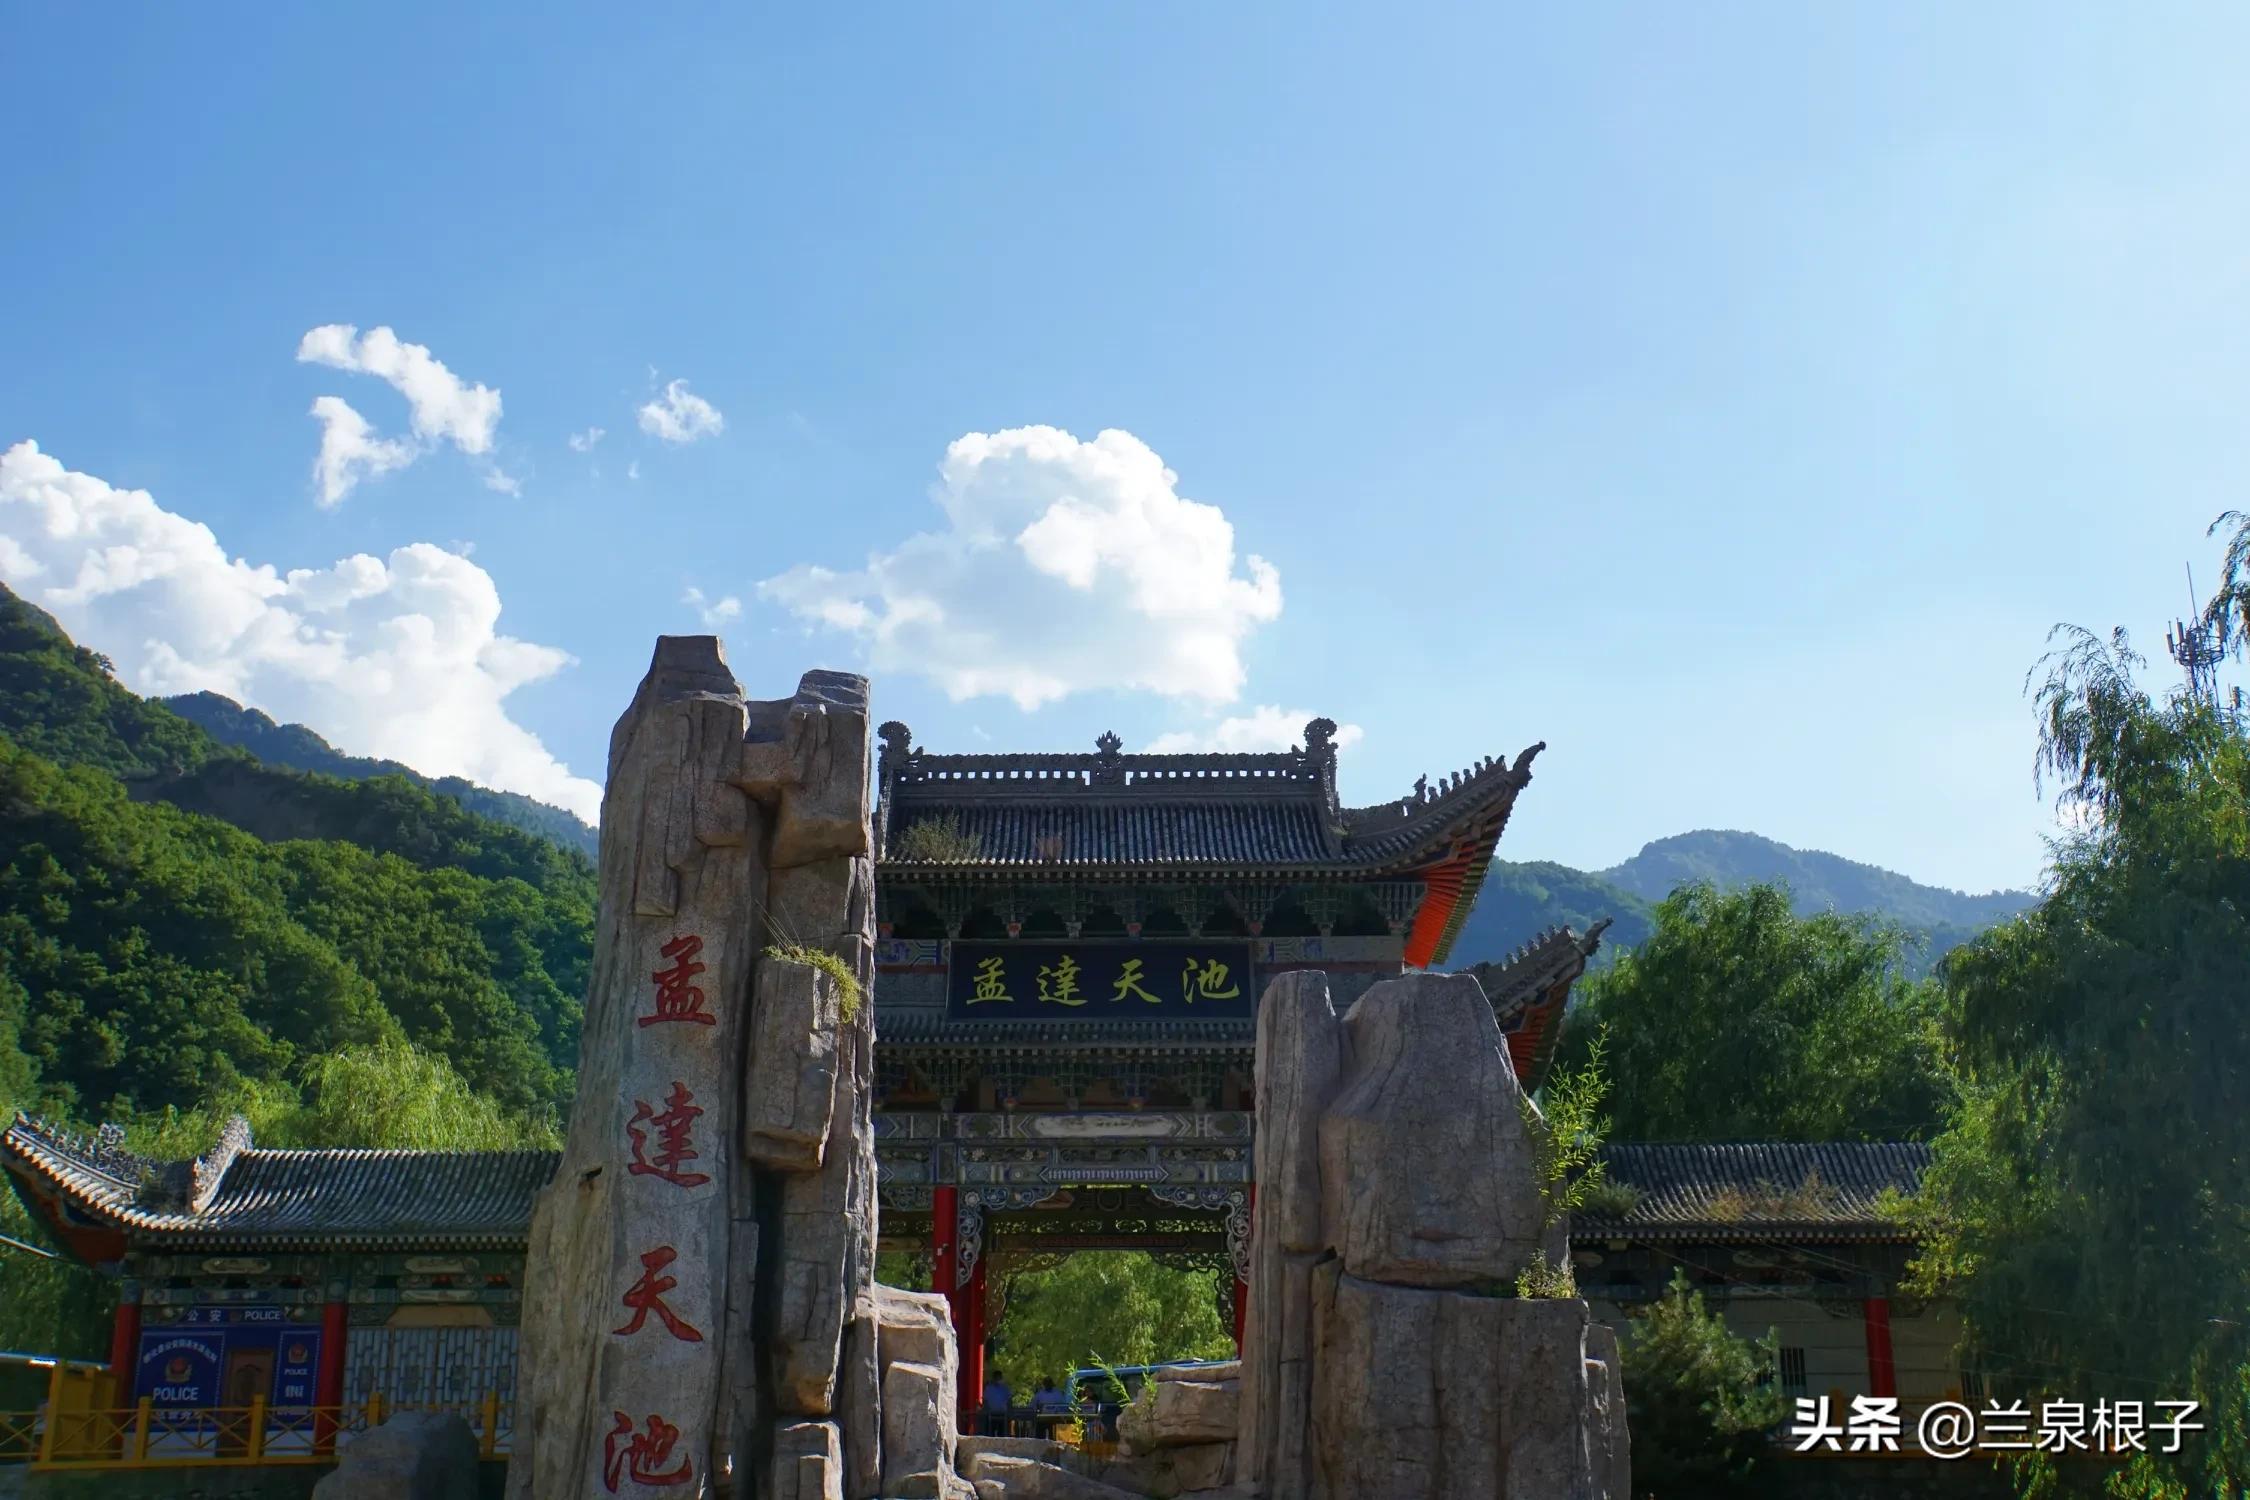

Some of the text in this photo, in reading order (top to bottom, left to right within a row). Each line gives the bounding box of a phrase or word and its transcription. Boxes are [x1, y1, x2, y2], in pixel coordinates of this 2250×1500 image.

[966, 954, 1240, 1006] 孟達天池
[604, 935, 717, 1492] 孟達天池
[187, 1309, 281, 1322] 公安 POLICE
[283, 1368, 308, 1376] POLICE
[152, 1386, 199, 1401] POLICE
